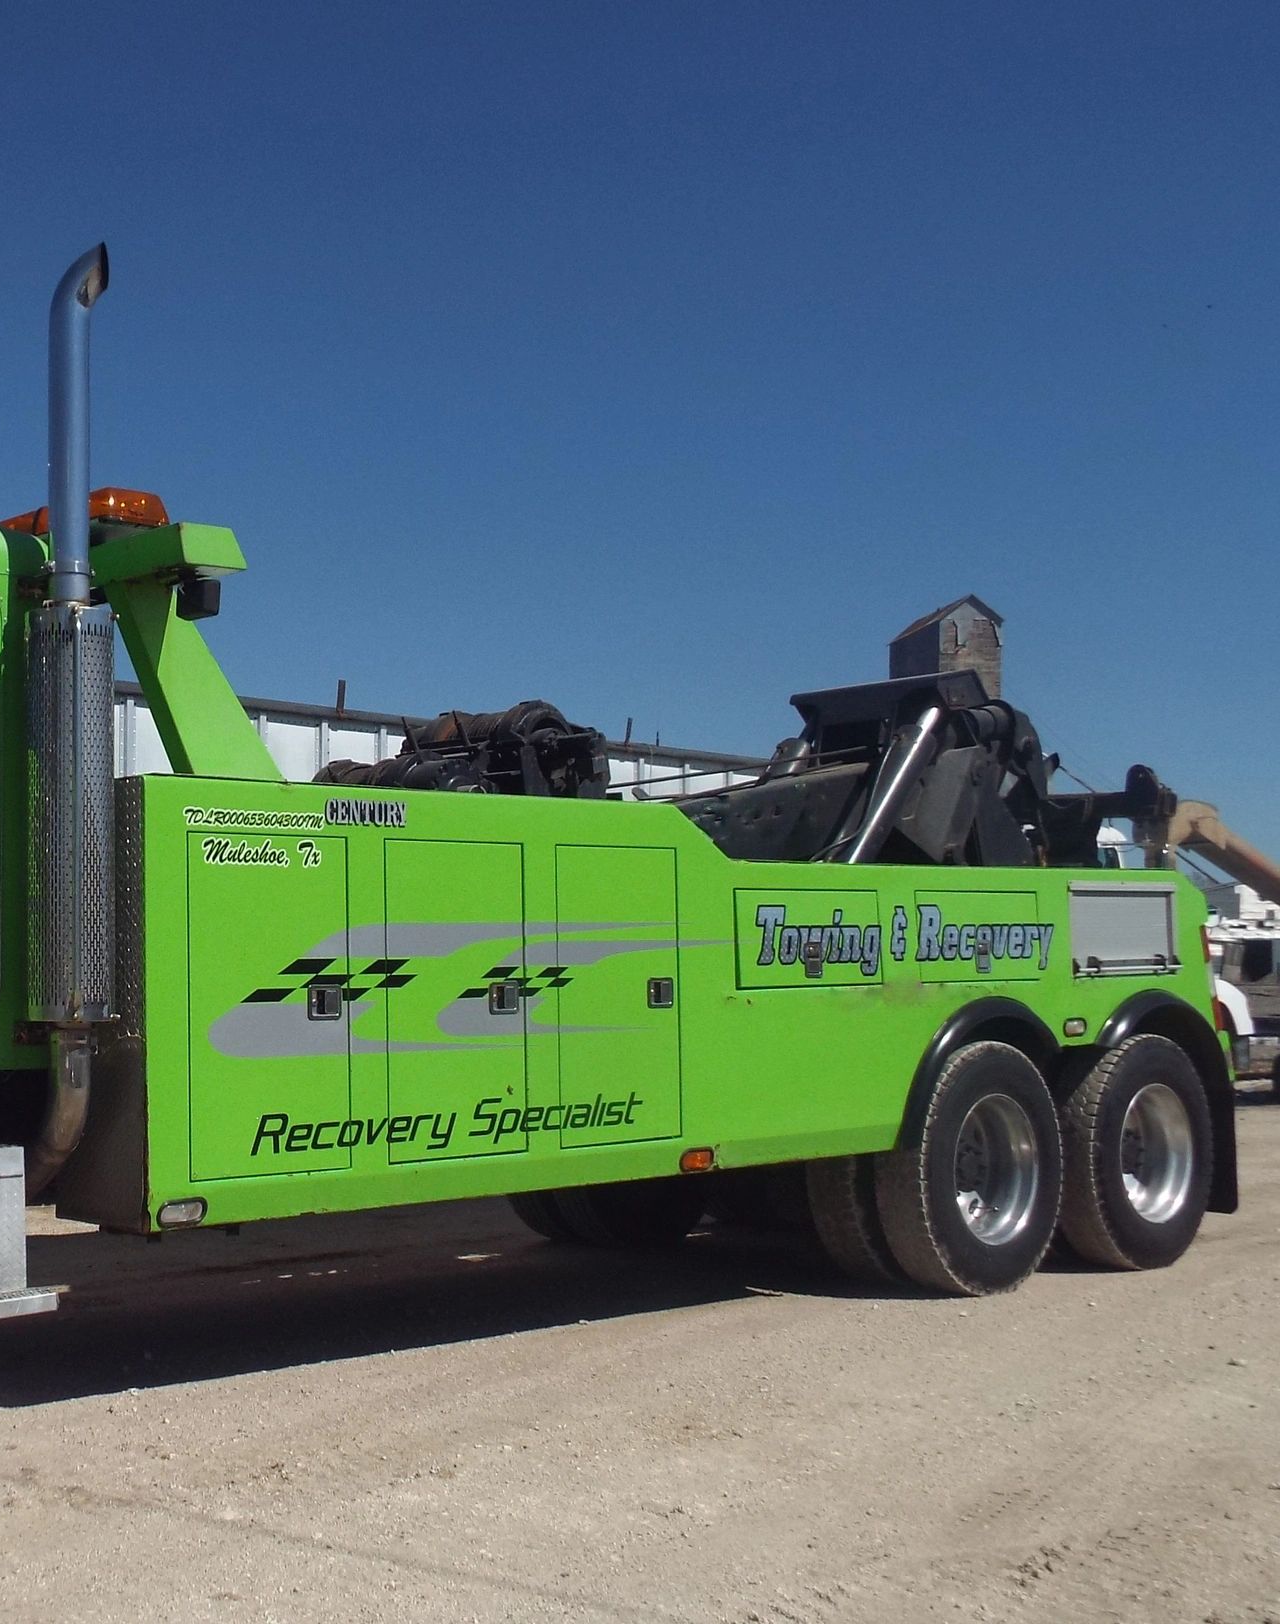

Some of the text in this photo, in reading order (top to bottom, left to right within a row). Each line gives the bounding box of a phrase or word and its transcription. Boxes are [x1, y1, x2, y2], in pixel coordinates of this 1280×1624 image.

[324, 798, 407, 828] CENTURY
[202, 837, 322, 868] Muleshoe, Tx
[890, 905, 908, 962] &
[250, 1091, 643, 1157] Recovery Specialist
